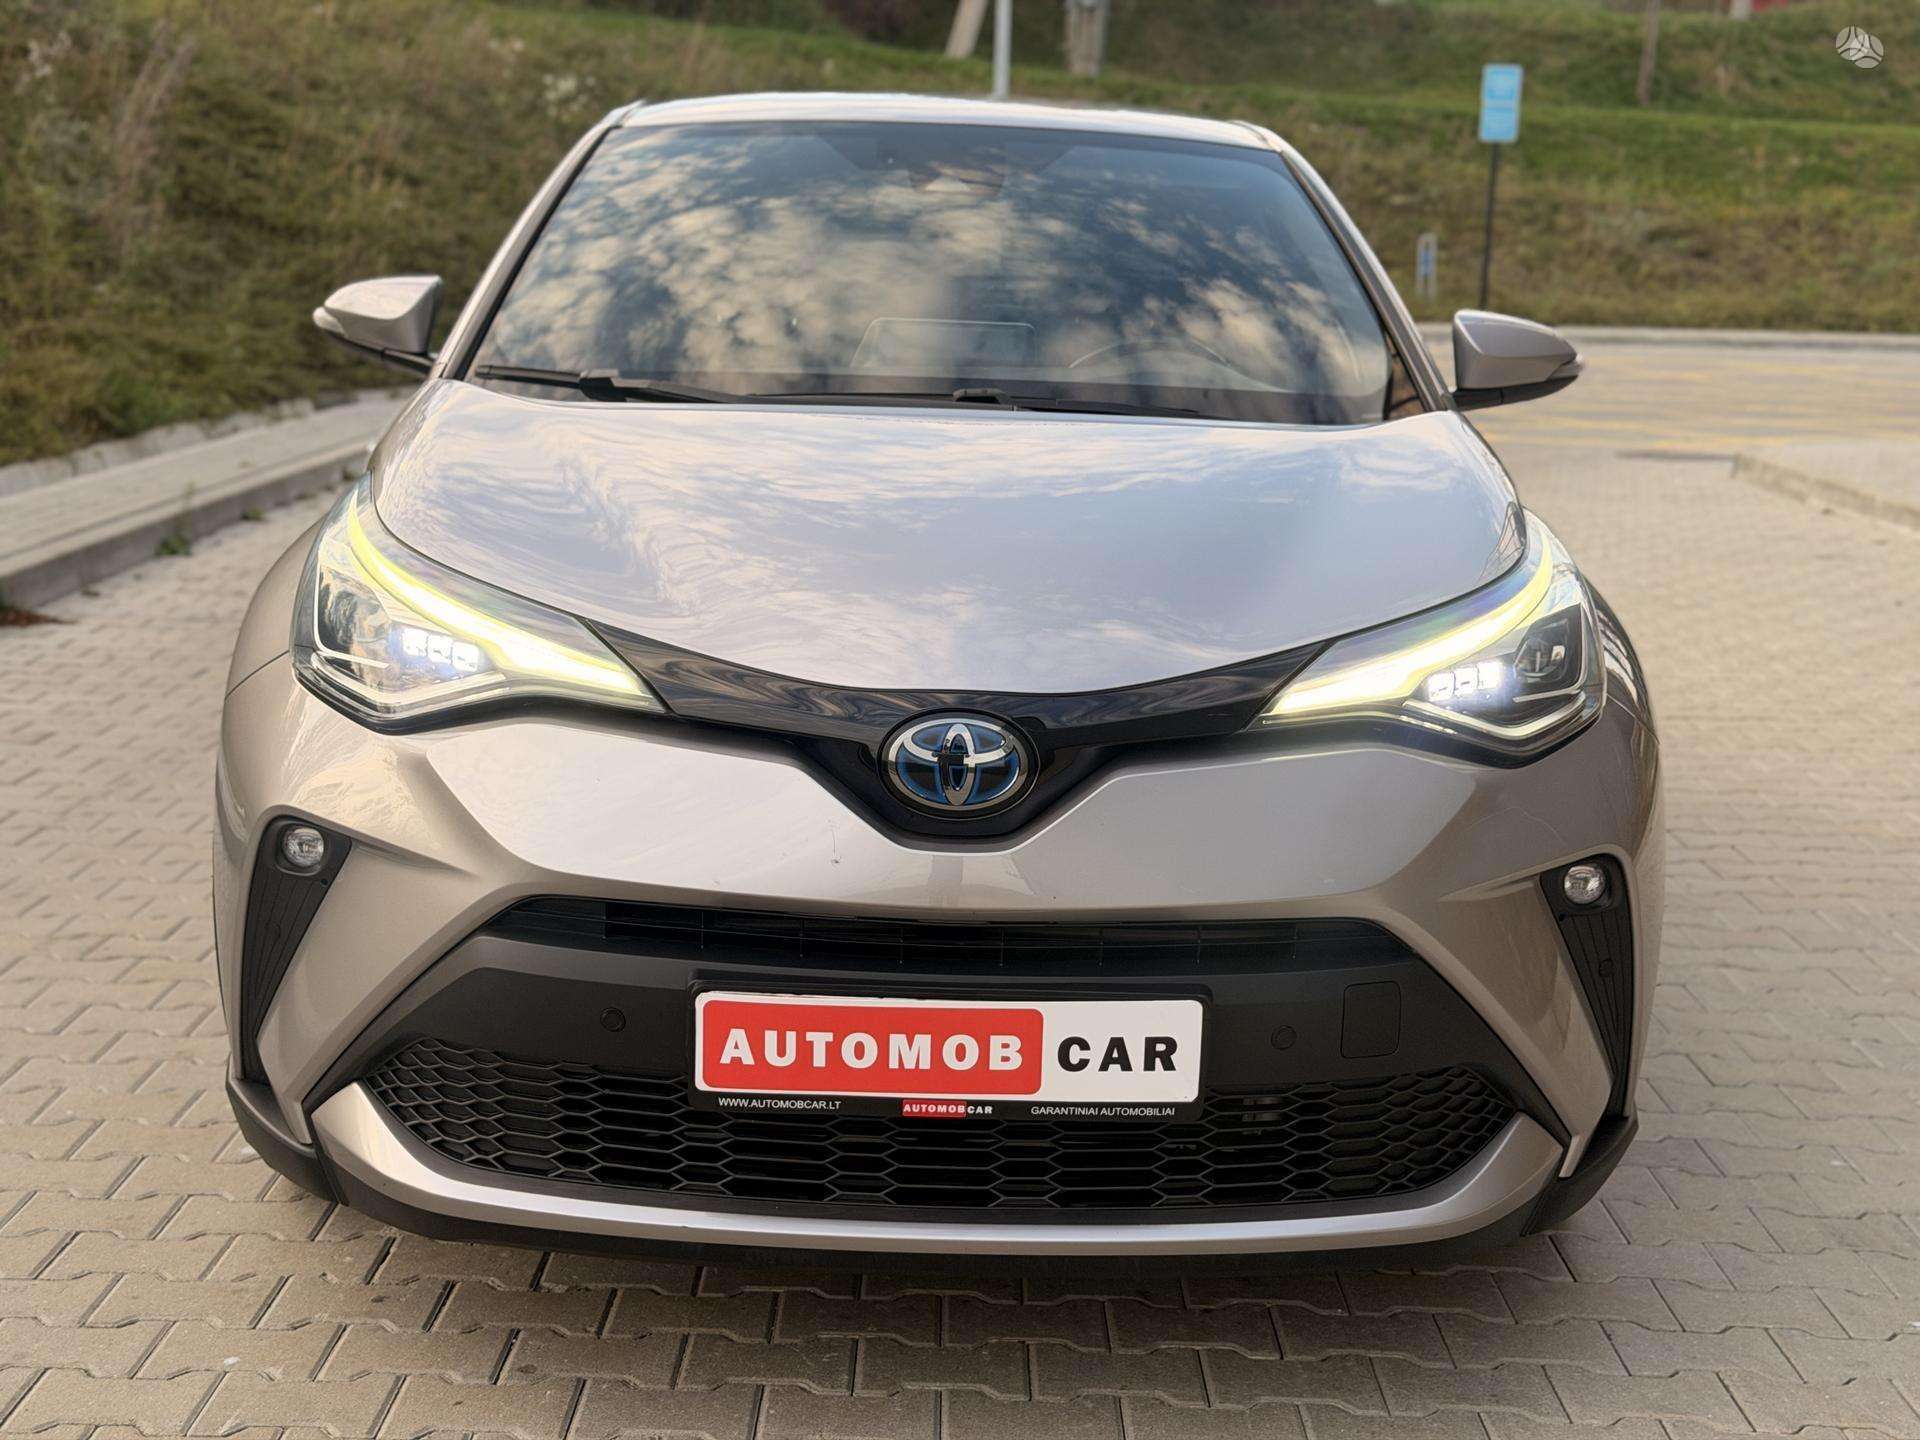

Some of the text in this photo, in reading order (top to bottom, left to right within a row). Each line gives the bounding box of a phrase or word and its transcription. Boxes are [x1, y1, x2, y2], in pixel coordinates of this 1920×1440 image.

[719, 1027, 1179, 1073] AUTOMOB CAR
[717, 1097, 841, 1110] WWW.AUTOMOBCAR.LT
[1030, 1106, 1175, 1117] GARANTINIAI AUTOMOBILIAI
